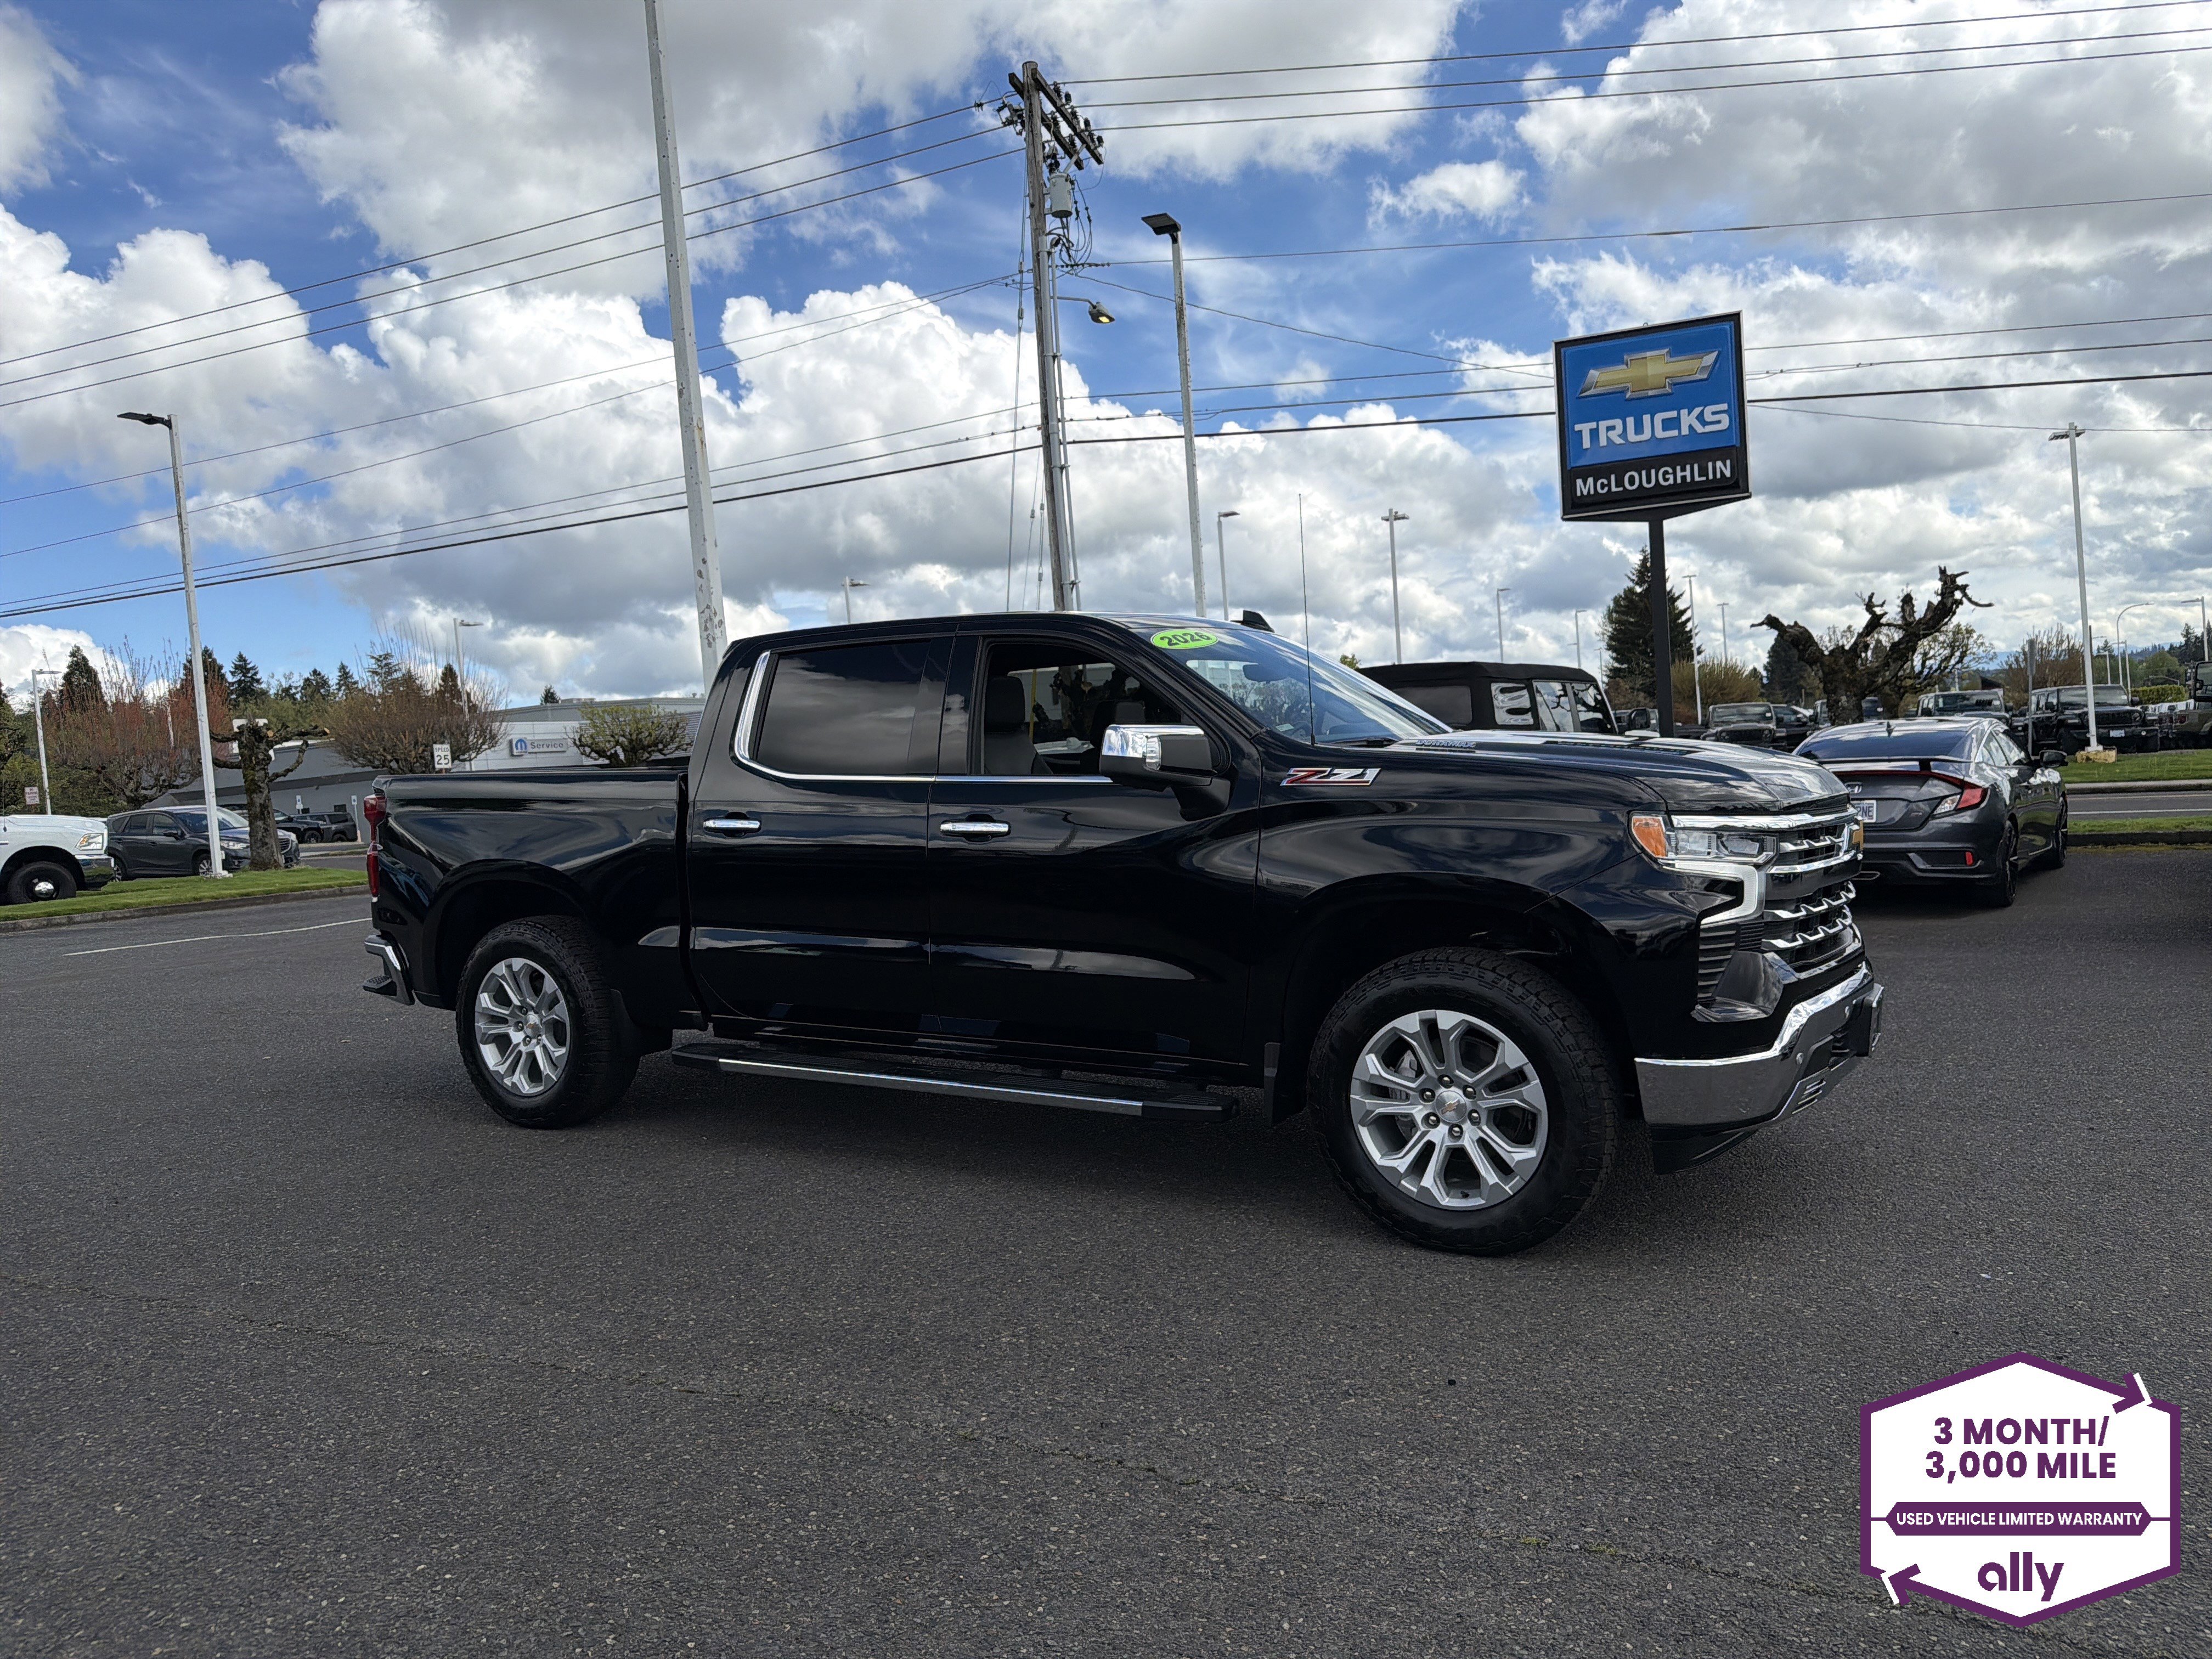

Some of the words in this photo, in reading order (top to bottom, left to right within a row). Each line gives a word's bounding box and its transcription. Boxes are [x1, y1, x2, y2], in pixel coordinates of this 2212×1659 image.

[1574, 403, 1730, 450] TRUCKS
[1576, 459, 1731, 496] McLOUGHLIN
[1159, 632, 1212, 647] 2026
[530, 741, 563, 749] Service
[1415, 739, 1476, 748] DURAMAX
[436, 754, 450, 765] 25
[1280, 768, 1382, 786] Z71
